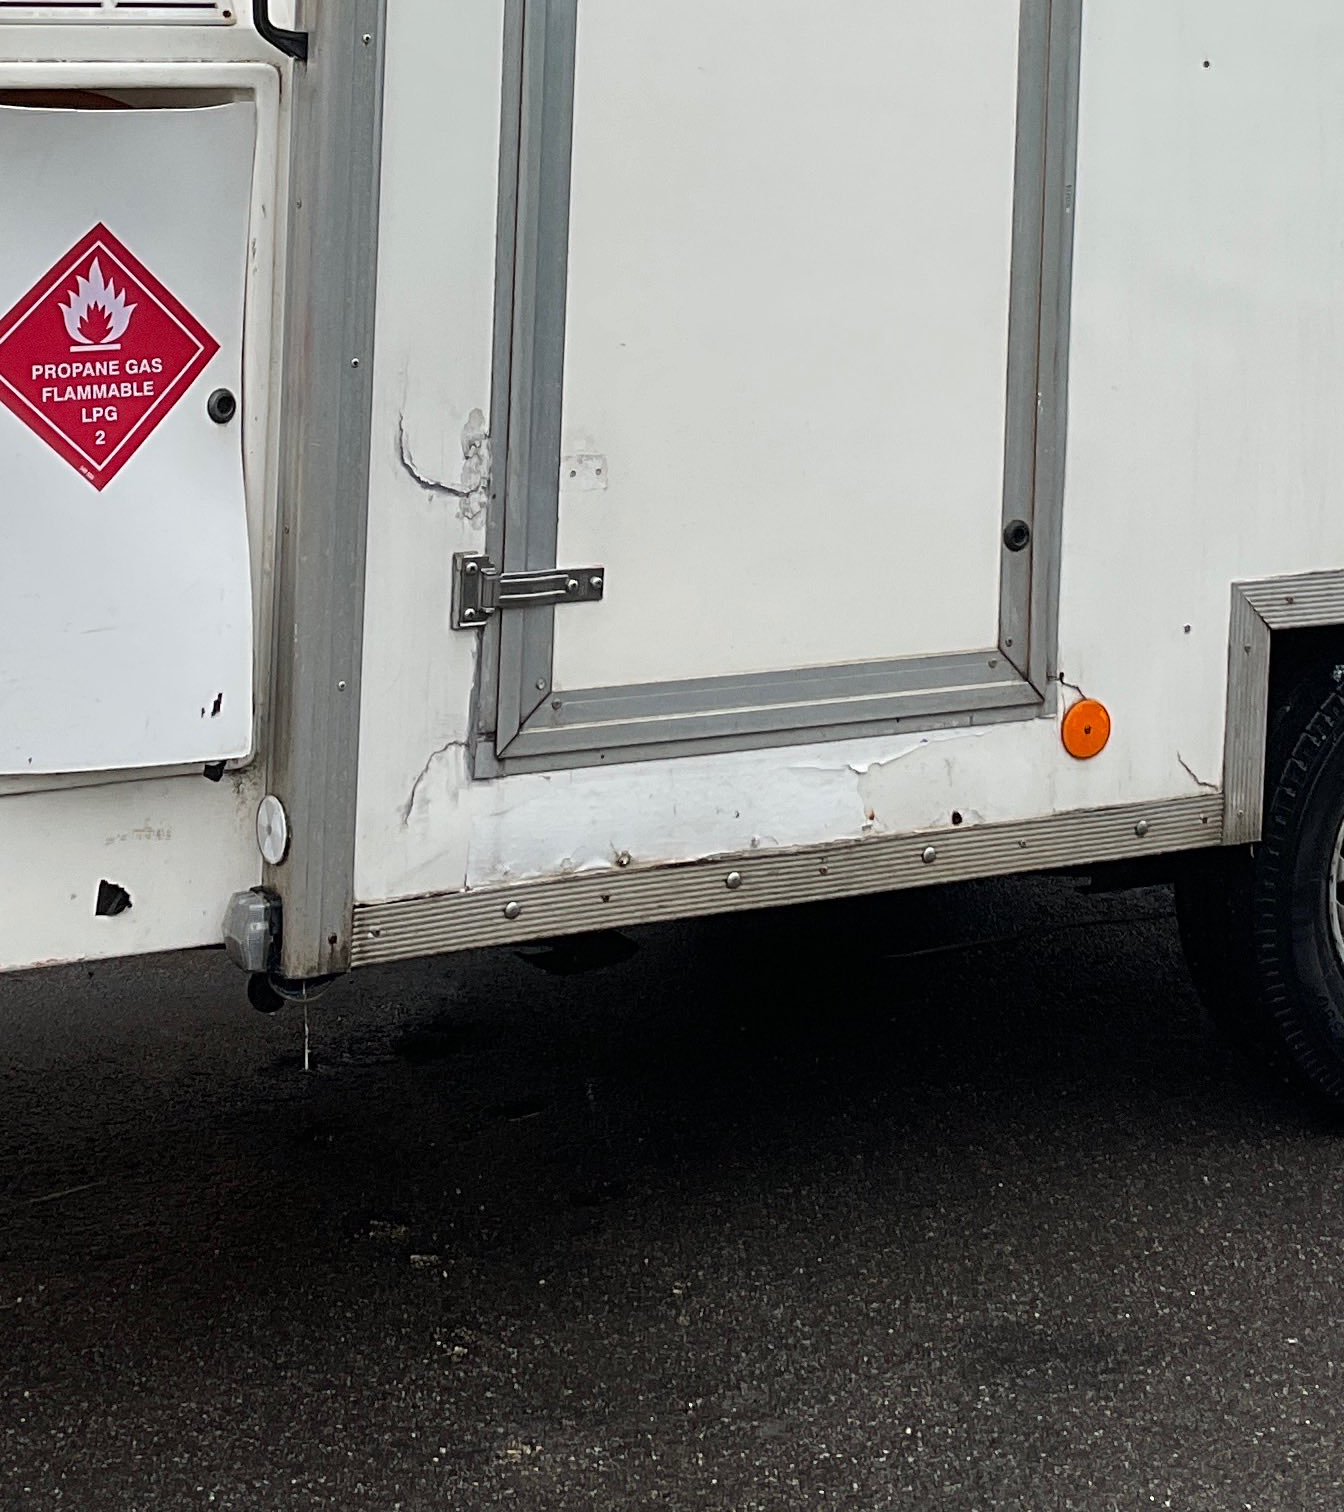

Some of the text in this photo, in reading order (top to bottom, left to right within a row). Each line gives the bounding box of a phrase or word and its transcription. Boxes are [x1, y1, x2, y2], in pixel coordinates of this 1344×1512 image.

[31, 358, 163, 380] PROPANE GAS
[42, 381, 154, 402] FLAMMABLE
[81, 406, 118, 423] LPG
[95, 430, 106, 445] 2
